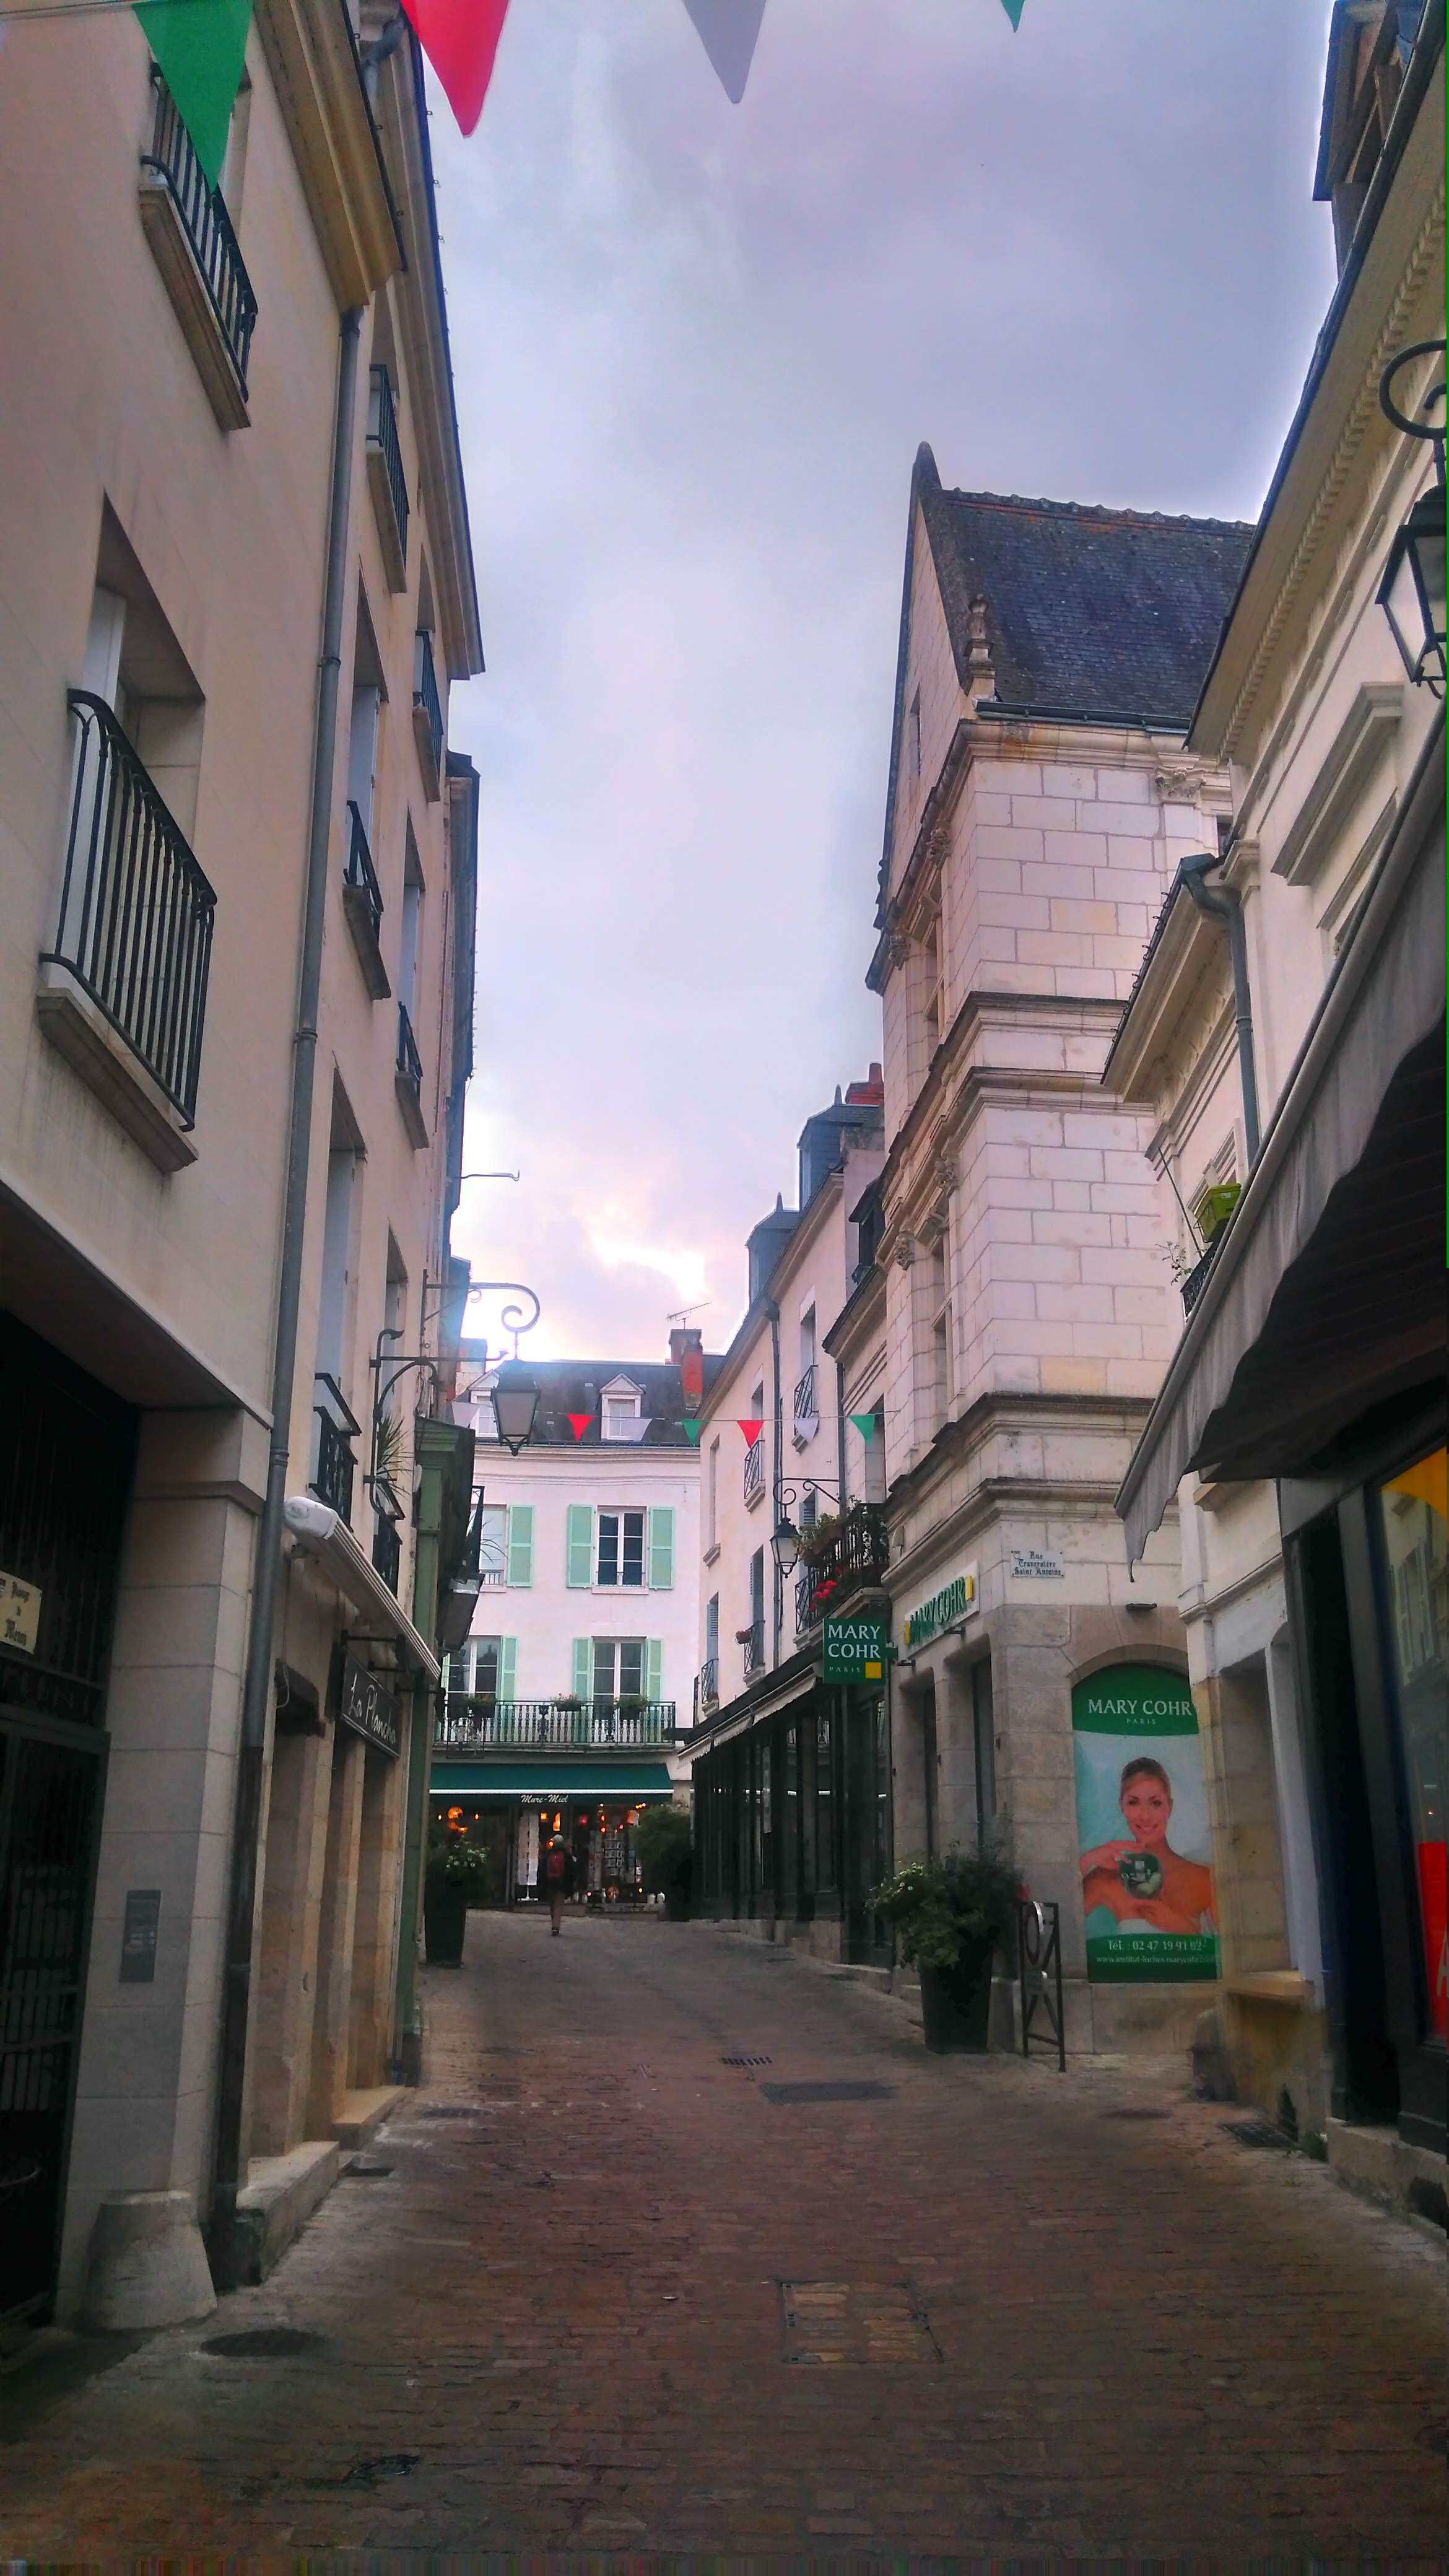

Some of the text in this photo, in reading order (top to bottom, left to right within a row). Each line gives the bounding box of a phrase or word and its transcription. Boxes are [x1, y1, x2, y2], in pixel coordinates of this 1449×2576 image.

[1029, 1551, 1043, 1559] Rue
[1014, 1567, 1061, 1575] Saint Antoine
[828, 1624, 881, 1640] MARY
[827, 1643, 881, 1658] COHR
[347, 1673, 396, 1744] La Plancha
[1088, 1699, 1193, 1716] MARY COHR
[520, 1794, 569, 1803] Mure-Miel
[1132, 1940, 1144, 1951] 02
[1147, 1940, 1159, 1951] 47
[1163, 1940, 1173, 1951] 19
[1176, 1939, 1188, 1951] 91
